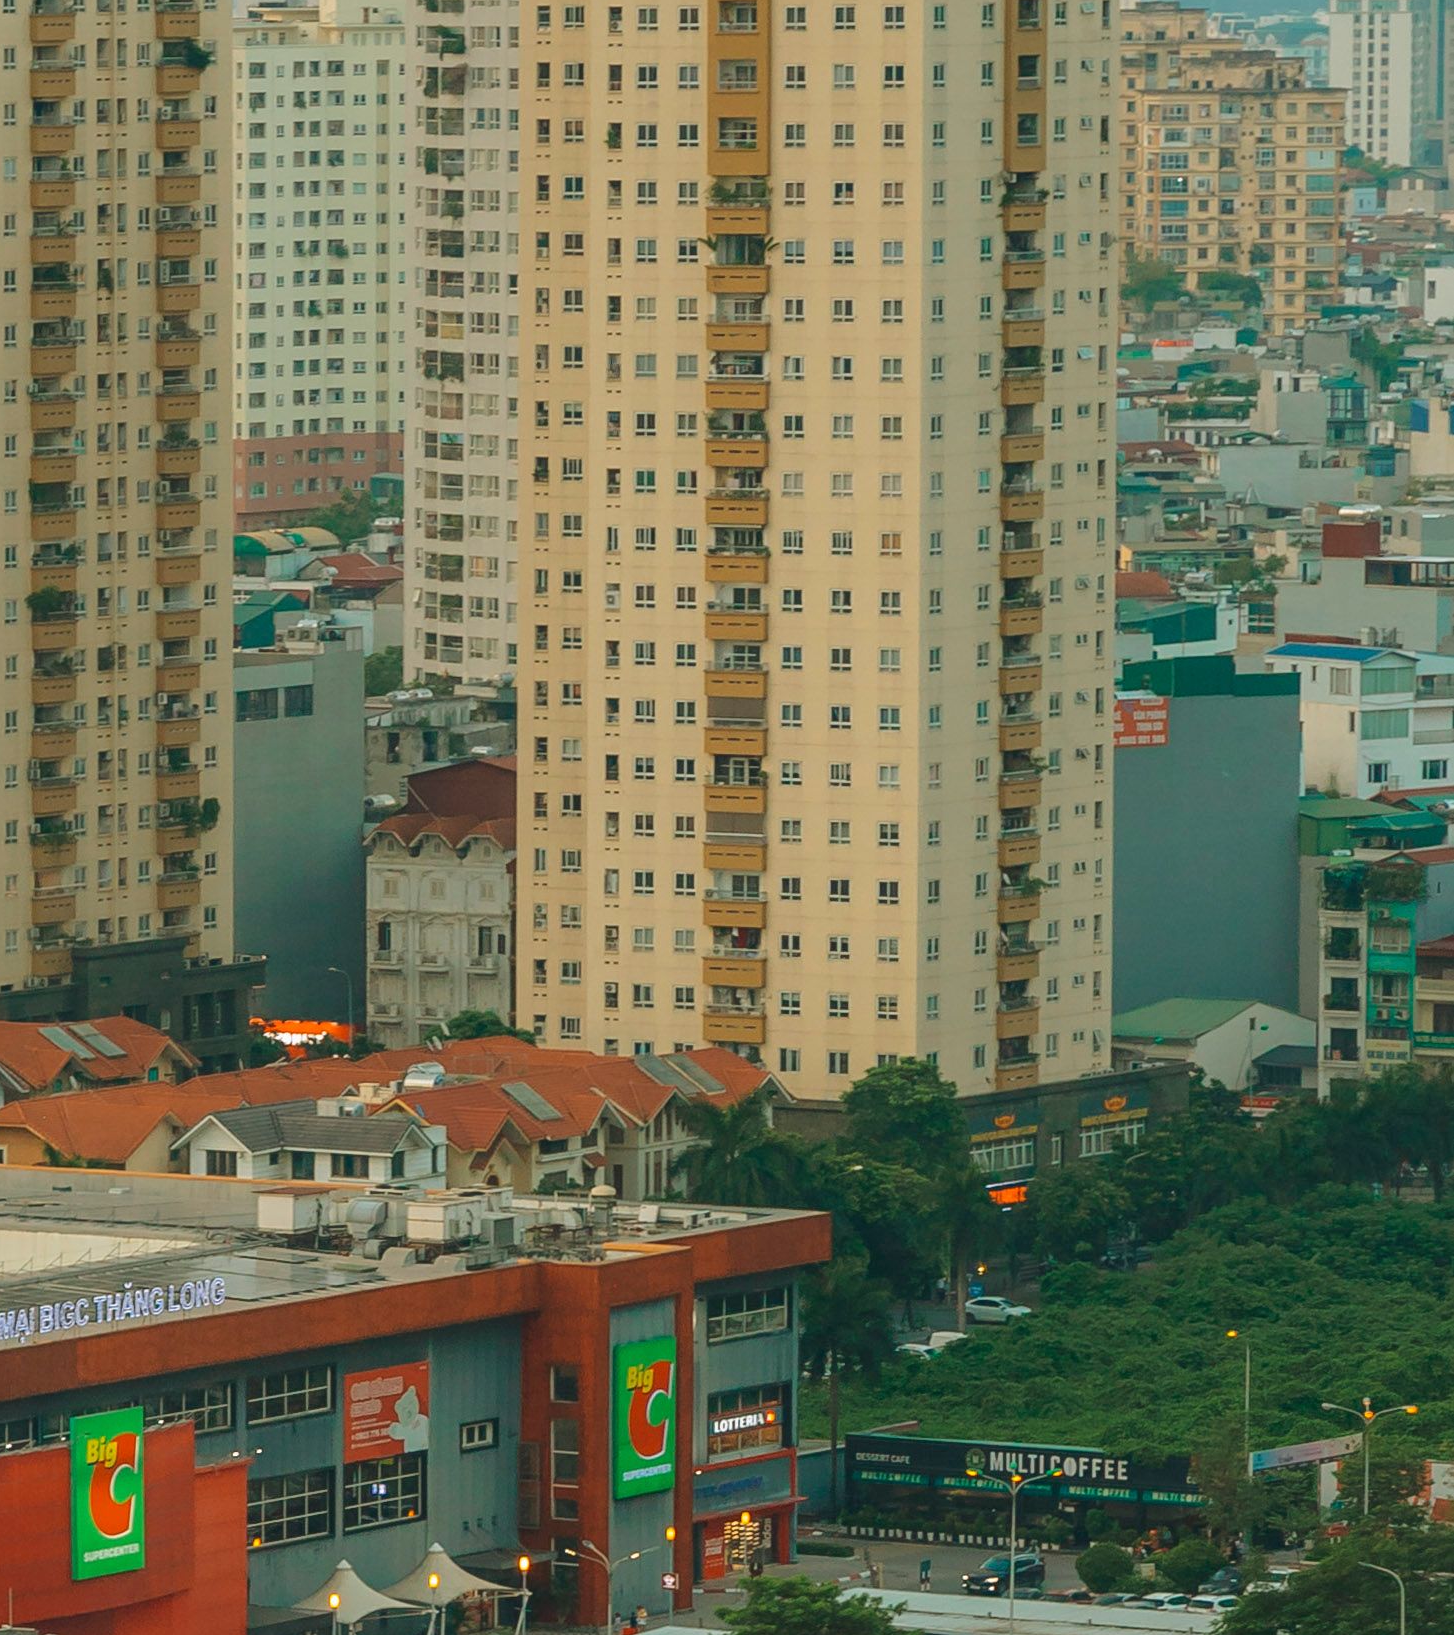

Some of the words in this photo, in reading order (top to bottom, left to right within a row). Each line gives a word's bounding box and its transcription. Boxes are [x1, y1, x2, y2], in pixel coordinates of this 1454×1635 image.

[39, 1298, 89, 1334] BIGC
[94, 1282, 164, 1324] THĂNG
[168, 1277, 226, 1313] LONG
[626, 1364, 654, 1394] Big
[628, 1359, 674, 1460] C
[714, 1413, 765, 1434] LOTTERIA
[86, 1436, 118, 1469] Big
[990, 1451, 1043, 1475] MULTI
[1050, 1455, 1129, 1481] COFFEE
[89, 1432, 140, 1539] C
